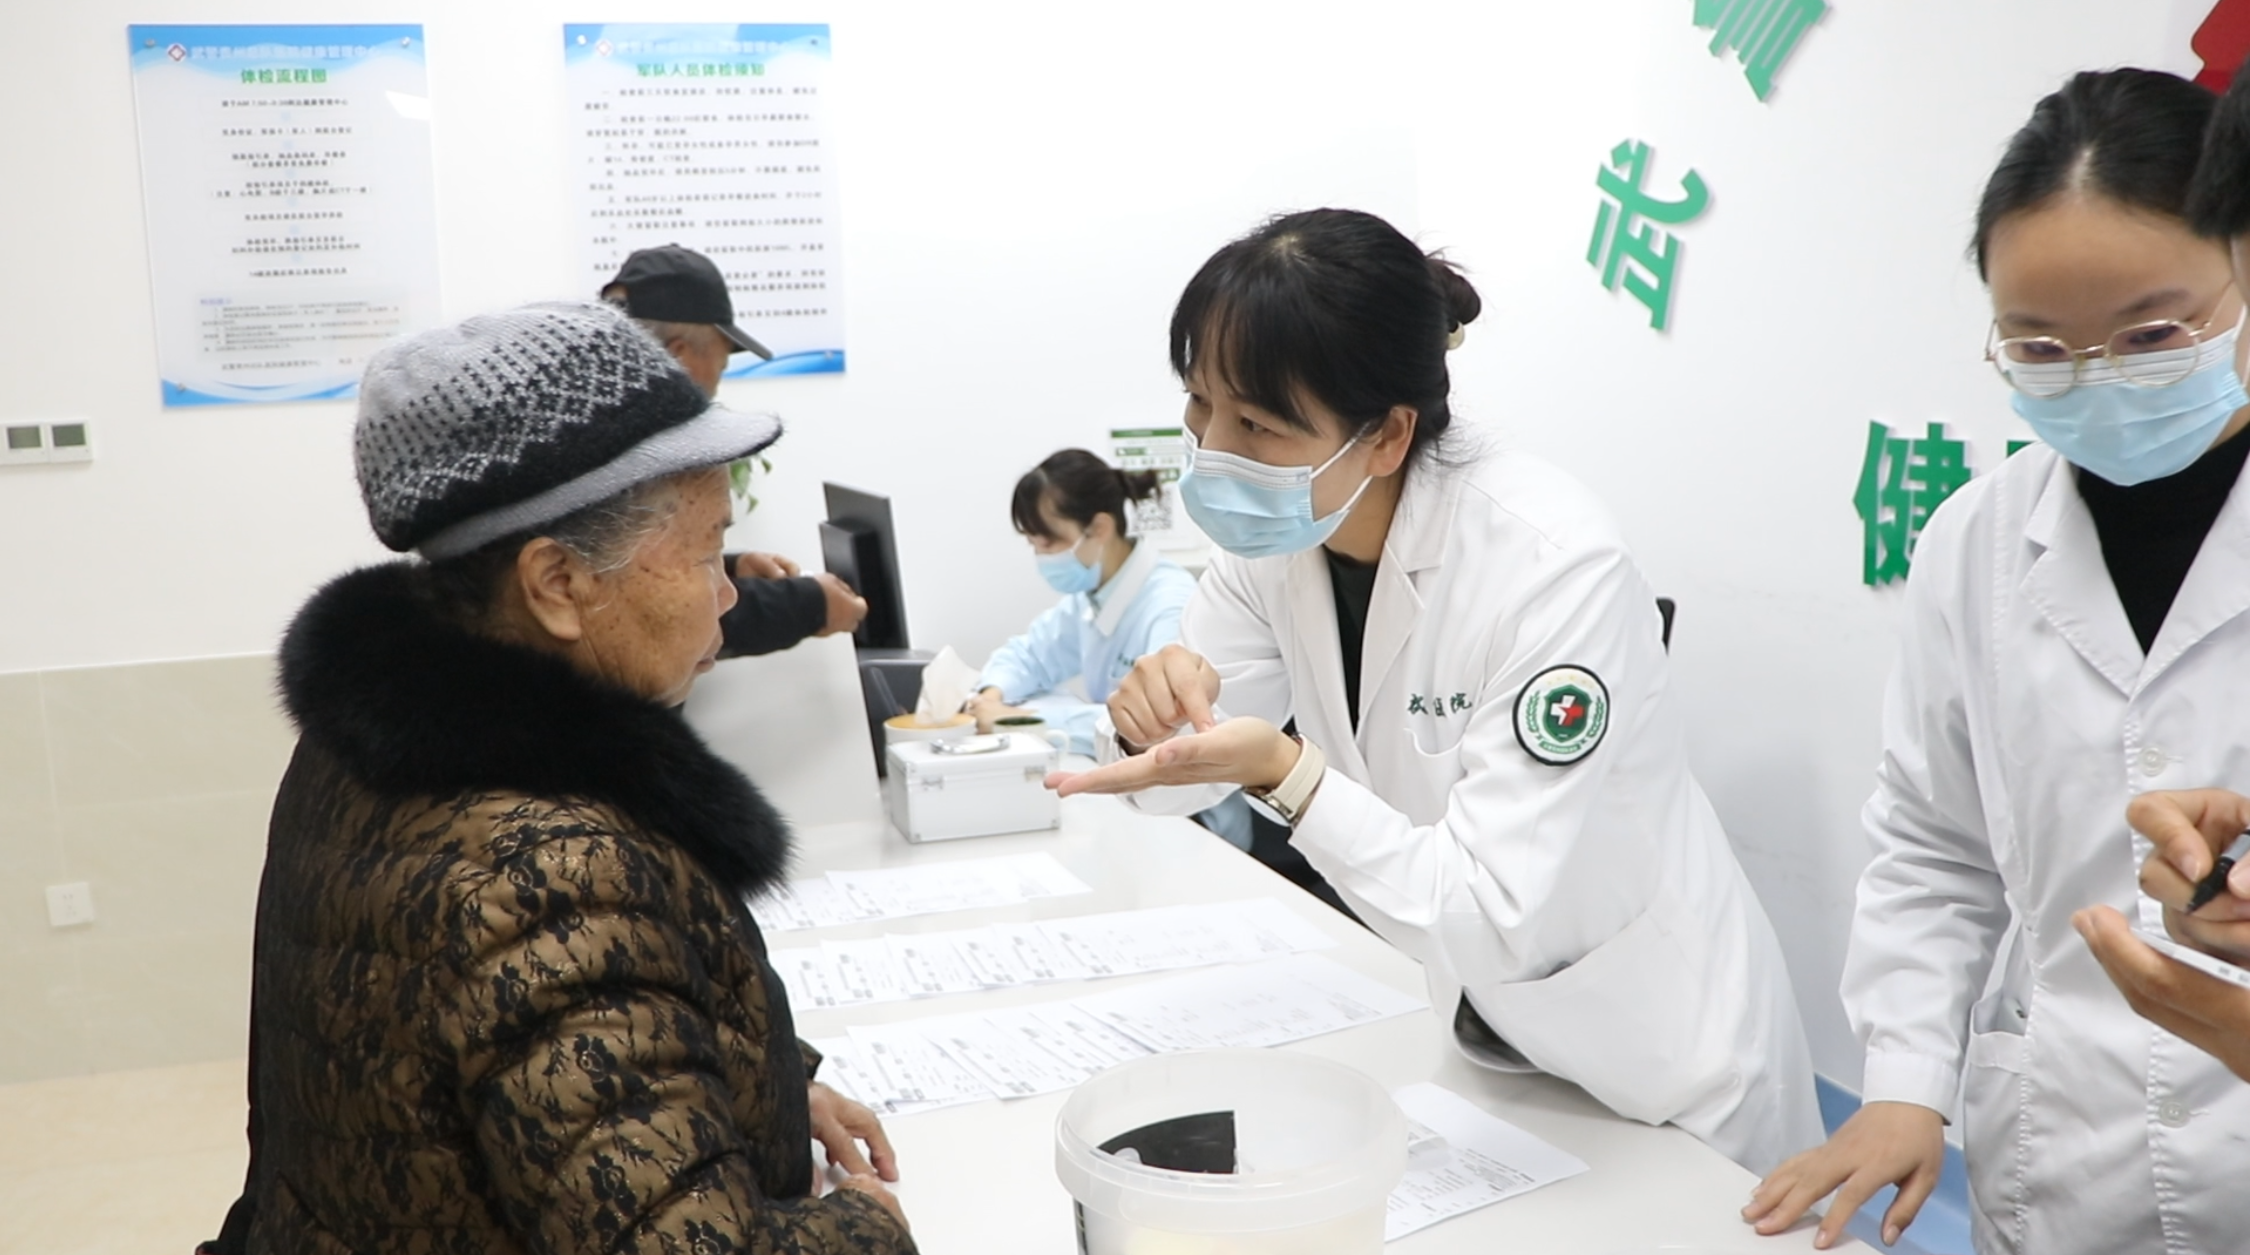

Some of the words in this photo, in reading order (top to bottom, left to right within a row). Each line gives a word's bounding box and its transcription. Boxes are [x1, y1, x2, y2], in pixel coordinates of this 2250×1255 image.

[241, 68, 328, 84] 体检流程图
[637, 63, 766, 77] 军队人员体检须知
[1586, 138, 1709, 330] 武
